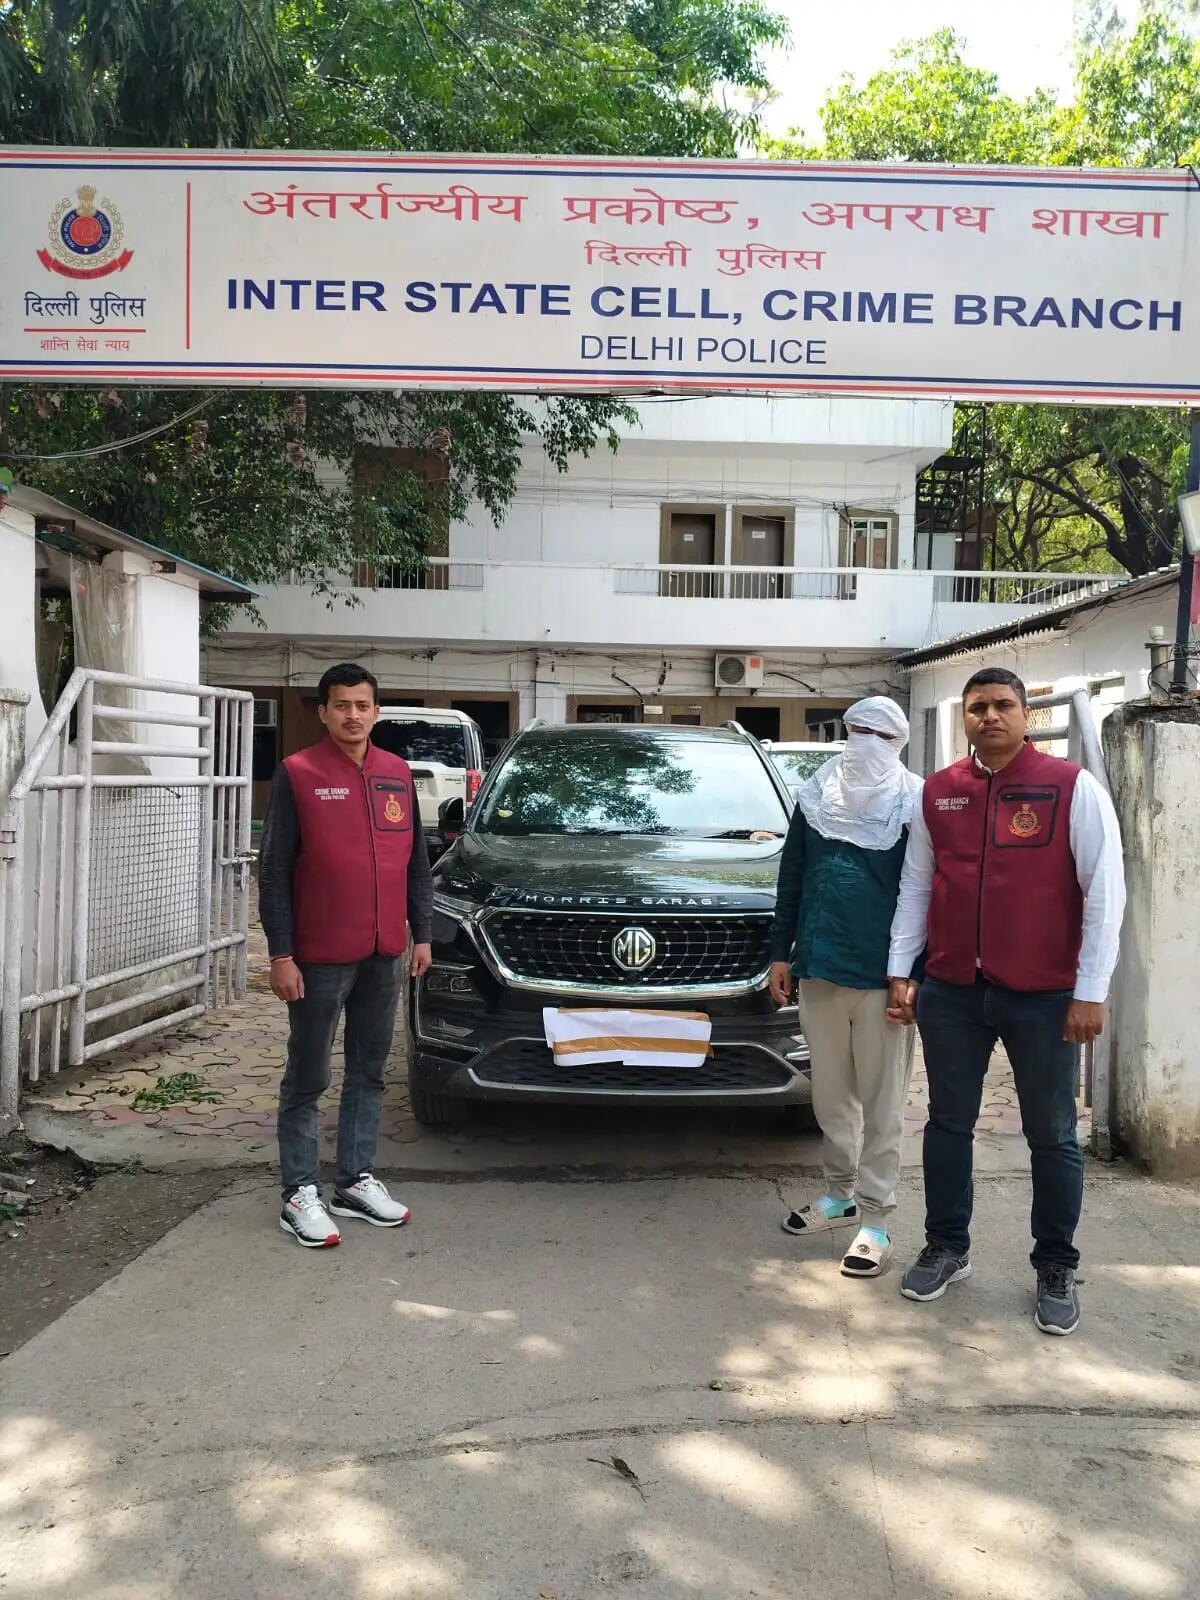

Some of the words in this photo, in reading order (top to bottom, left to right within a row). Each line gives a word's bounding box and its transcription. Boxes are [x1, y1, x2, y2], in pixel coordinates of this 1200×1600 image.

[243, 183, 528, 222] अंतर्राज्यीय
[563, 188, 758, 230] प्रकोष्ठ,
[801, 202, 994, 234] अपराध
[1032, 208, 1168, 239] शाखा
[585, 240, 691, 267] दिल्ली
[717, 243, 826, 276] पुलिस
[24, 291, 80, 316] दिल्ली
[89, 292, 146, 325] पुलिस
[229, 279, 387, 312] INTER
[405, 282, 570, 316] STATE
[590, 286, 742, 325] CELL,
[763, 289, 933, 324] CRIME
[954, 295, 1182, 332] BRANCH
[40, 336, 70, 351] शान्ति
[76, 336, 98, 351] सेवा
[104, 340, 130, 351] न्याय
[581, 336, 683, 361] DELHI
[697, 337, 827, 364] POLICE
[525, 895, 627, 904] MORRIS
[641, 897, 743, 905] GARAG
[617, 930, 651, 965] MG
